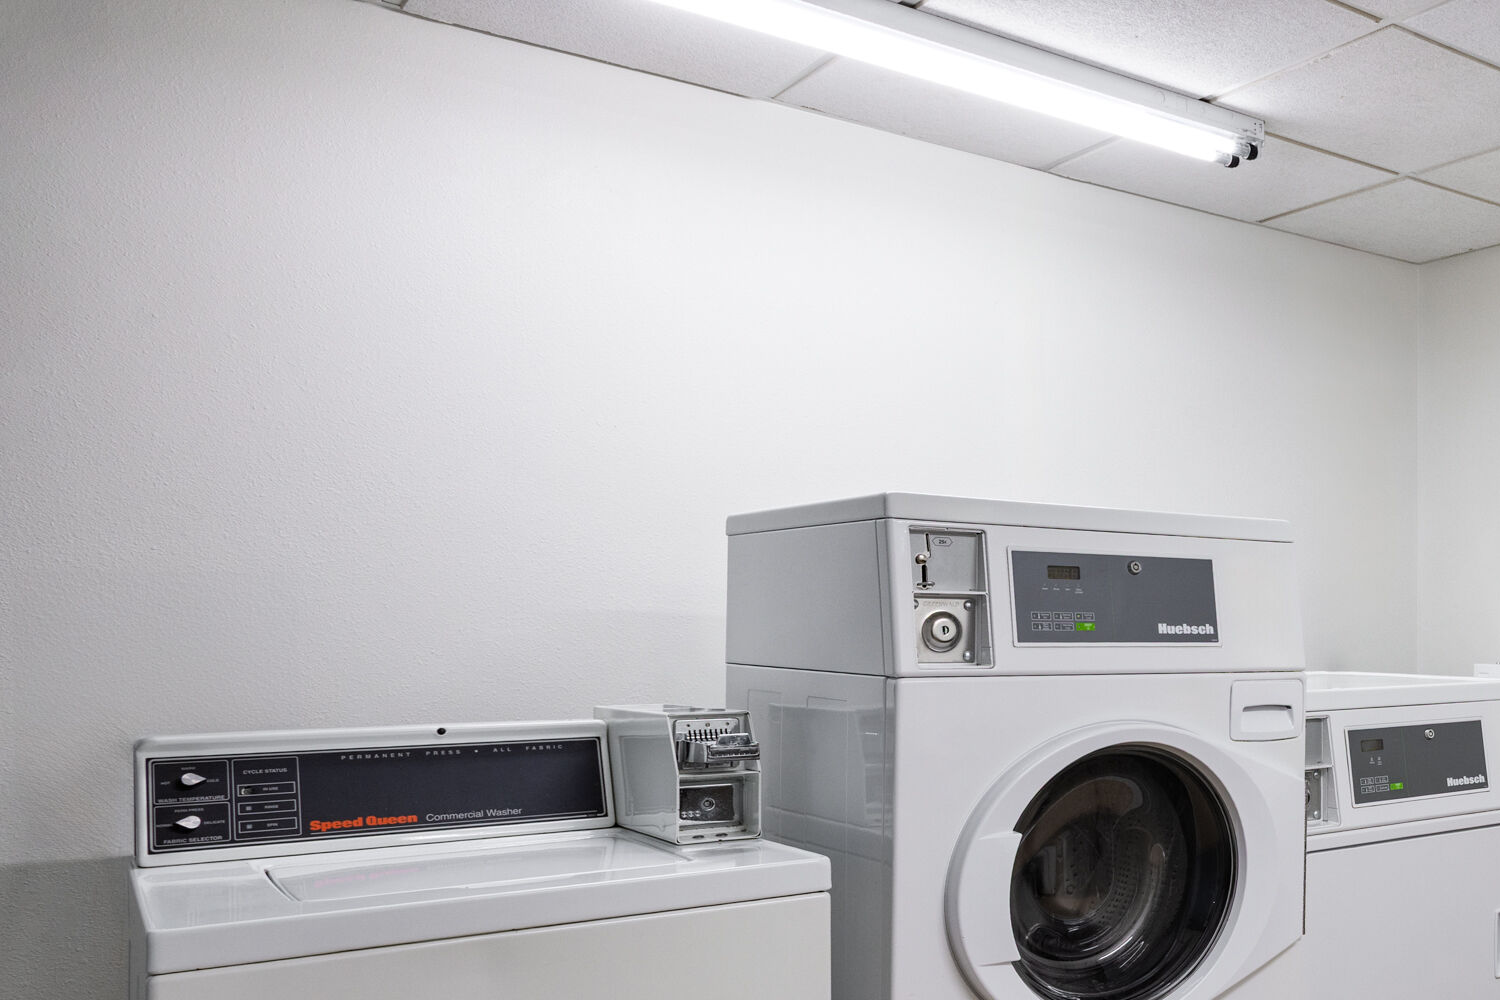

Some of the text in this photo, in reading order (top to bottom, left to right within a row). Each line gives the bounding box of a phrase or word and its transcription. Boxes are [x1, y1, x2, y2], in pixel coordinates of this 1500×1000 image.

[1157, 623, 1215, 635] Huebsch
[340, 752, 412, 761] PERMANENT
[1446, 774, 1486, 787] Huebsch
[178, 794, 226, 802] TEMPERATURE
[425, 807, 523, 822] Commercial Washer
[309, 814, 419, 832] Speed Queen
[188, 835, 223, 843] SELECTOR
